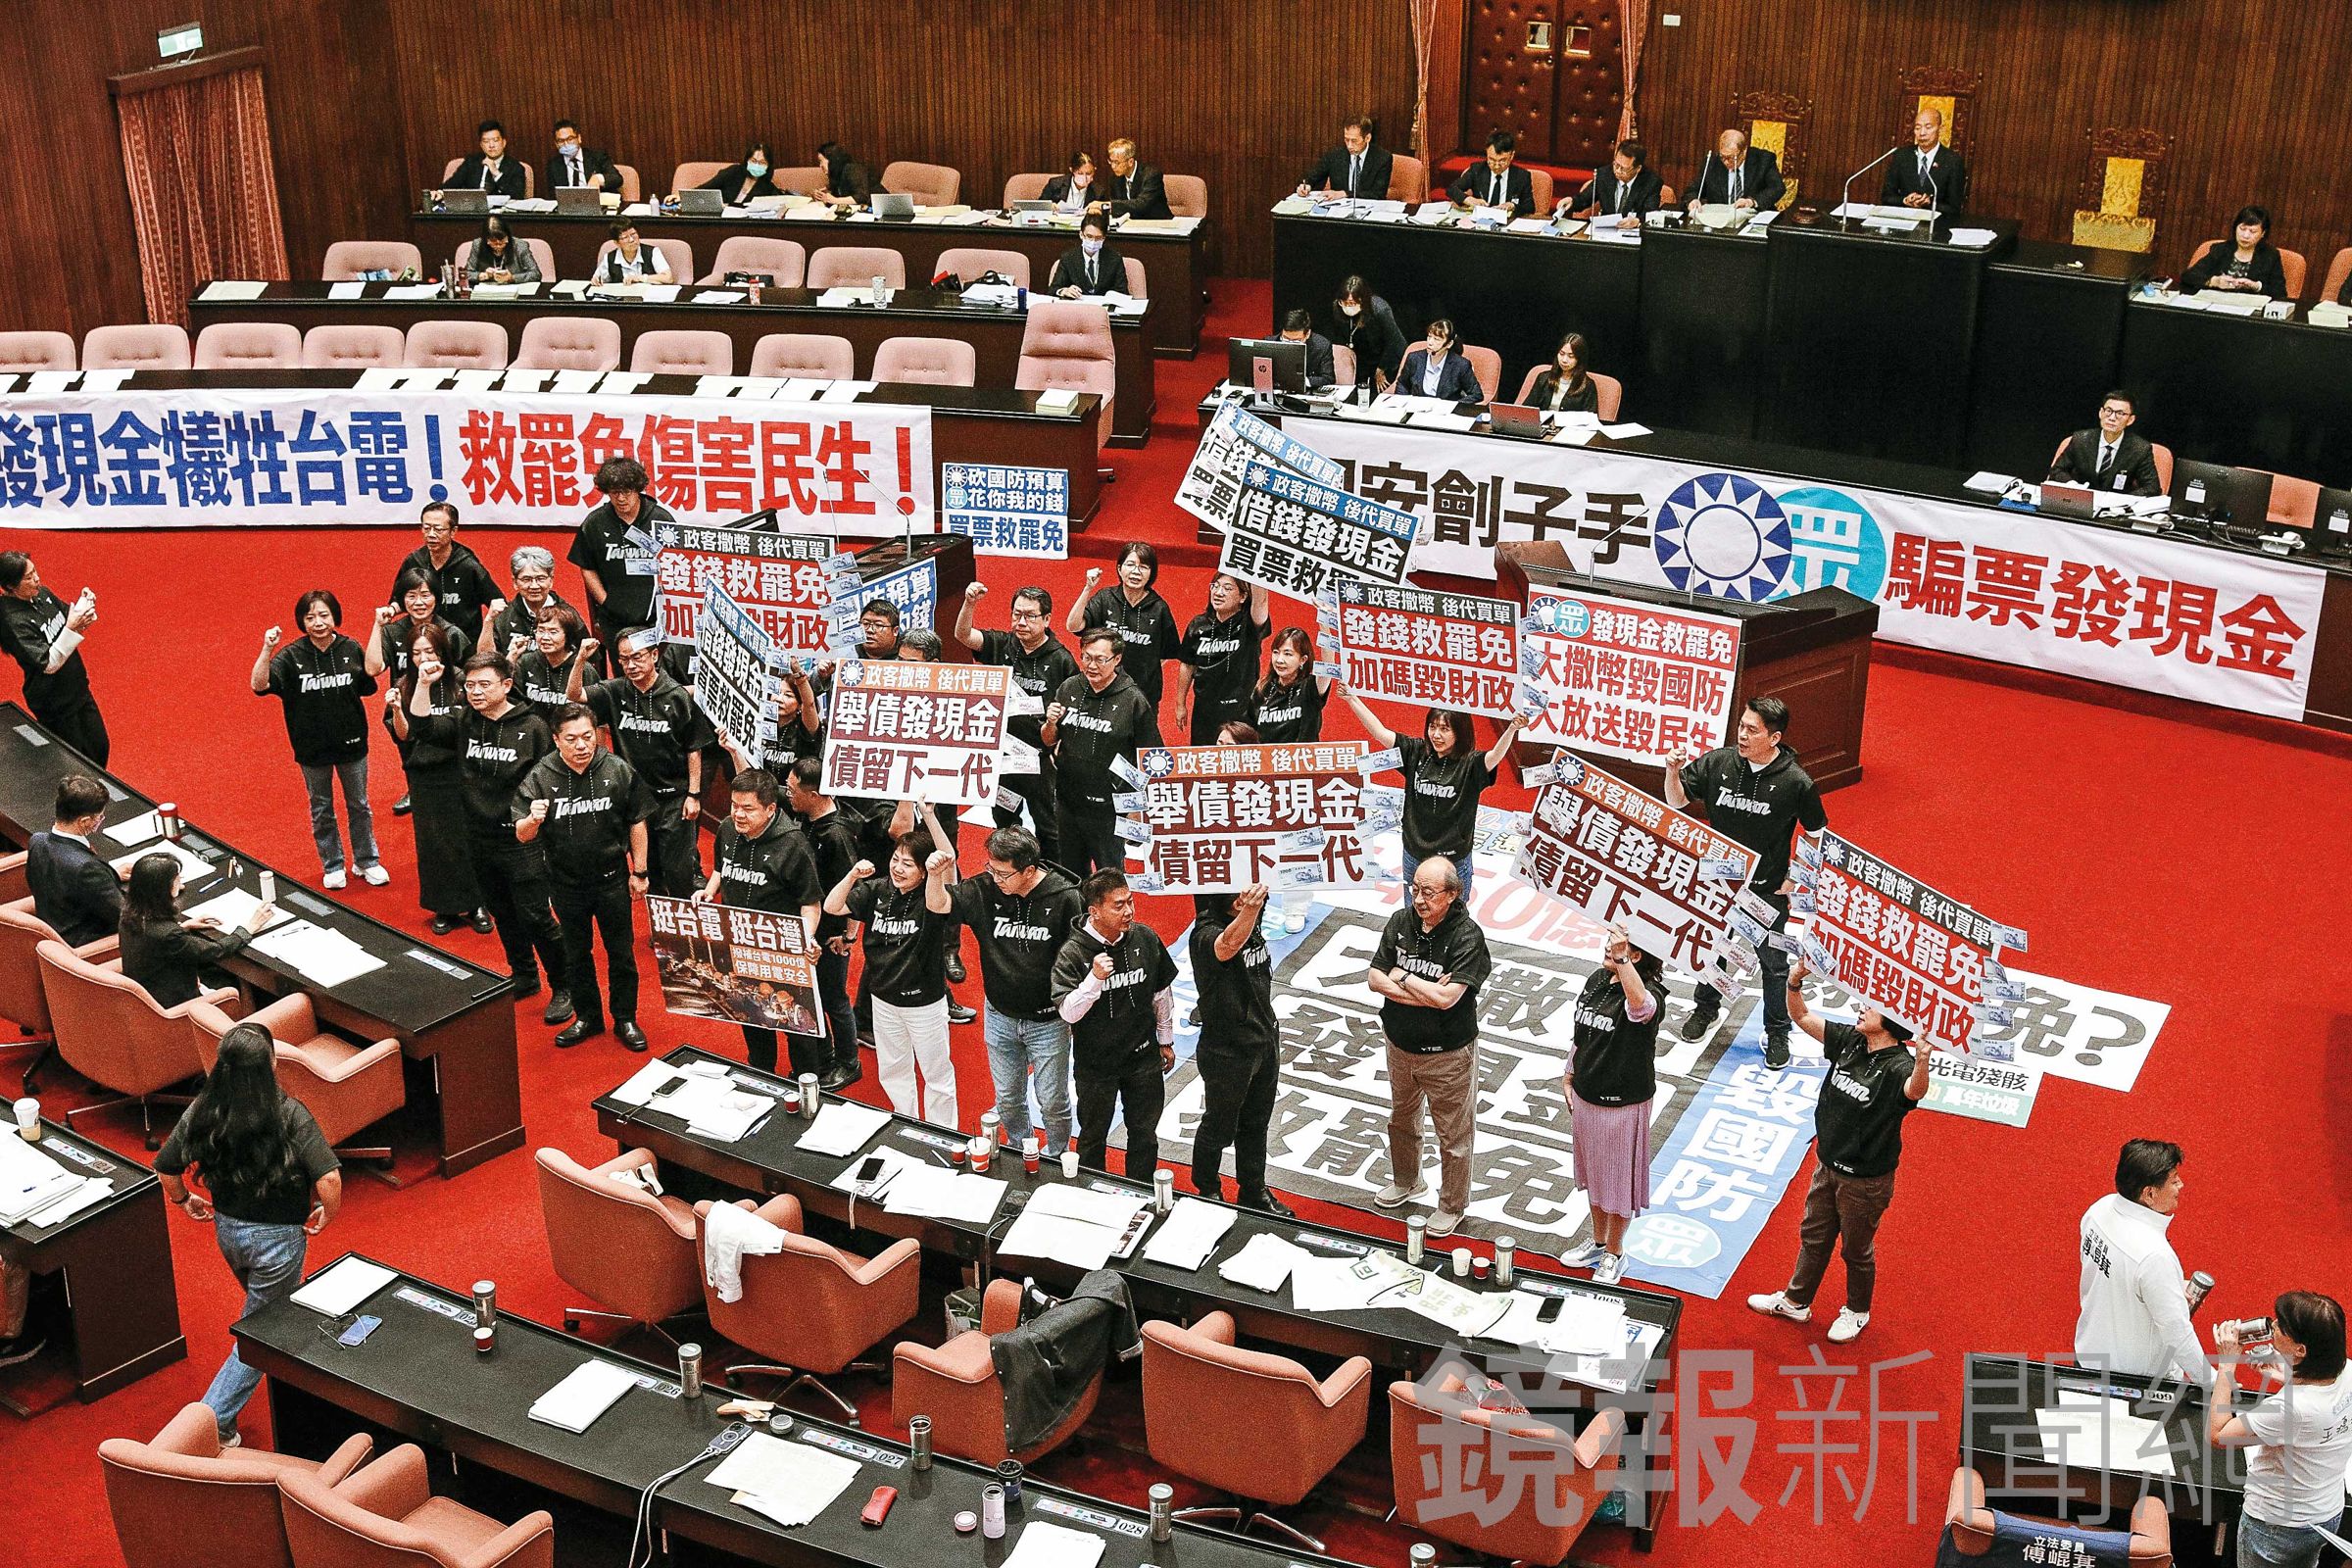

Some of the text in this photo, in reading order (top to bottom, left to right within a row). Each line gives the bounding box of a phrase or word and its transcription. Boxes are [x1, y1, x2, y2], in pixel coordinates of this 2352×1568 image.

[1236, 412, 1341, 483] 政客撒幣 後代買單
[967, 467, 1065, 493] 砍國防預算
[967, 488, 1064, 514] 花你我的錢
[1271, 474, 1413, 536] 政客撒幣 後代買單
[1330, 458, 1651, 564] 安劊子手
[683, 529, 826, 561] 政客撒幣 後代買單
[949, 514, 1064, 552] 買票救罷免
[1237, 489, 1406, 578] 借錢發現金
[659, 552, 828, 606] 發錢救罷免
[662, 597, 831, 653] 加財政
[1367, 587, 1511, 625] 政客撒幣 後代買單
[1558, 604, 1585, 634] 眾
[1886, 531, 2307, 681] 騙票發現金
[739, 616, 768, 659] 後代買單
[1196, 637, 1241, 656] Taiwan
[1343, 608, 1515, 668] 發錢救罷免
[1591, 609, 1734, 664] 發現金救罷免
[299, 671, 354, 694] Taiwan
[865, 664, 1004, 694] 政客撒幣 後代買單
[1347, 652, 1517, 714] 加碼毀財政
[1534, 641, 1728, 716] 大撒幣毀國防
[618, 710, 671, 733] Taiwan
[835, 691, 1002, 744] 舉債發現金
[1061, 707, 1113, 733] Taiwan
[1257, 706, 1303, 725] Taiwan
[466, 738, 518, 762] Taiwan
[1177, 747, 1358, 774] 政客撒幣 後代買單
[829, 744, 994, 799] 債留下一代
[553, 796, 613, 820] Taiwan
[1147, 777, 1361, 830] 舉債發現金
[1583, 773, 1665, 829] 政客撒幣
[1715, 785, 1772, 815] Taiwan
[720, 857, 768, 887] Taiwan
[1149, 835, 1365, 887] 債留下一代
[1846, 851, 1991, 947] 政客撒幣 後代買單
[651, 898, 804, 955] 挺台電 挺台灣
[871, 910, 919, 935] Taiwan
[993, 916, 1053, 942] Taiwan
[1816, 868, 1984, 1004] 發錢救罷免
[1649, 1062, 1822, 1223] 毀國防
[658, 1383, 681, 1396] 026
[879, 1452, 905, 1468] 027
[1118, 1522, 1145, 1535] 028
[2034, 1535, 2085, 1554] 立法委員
